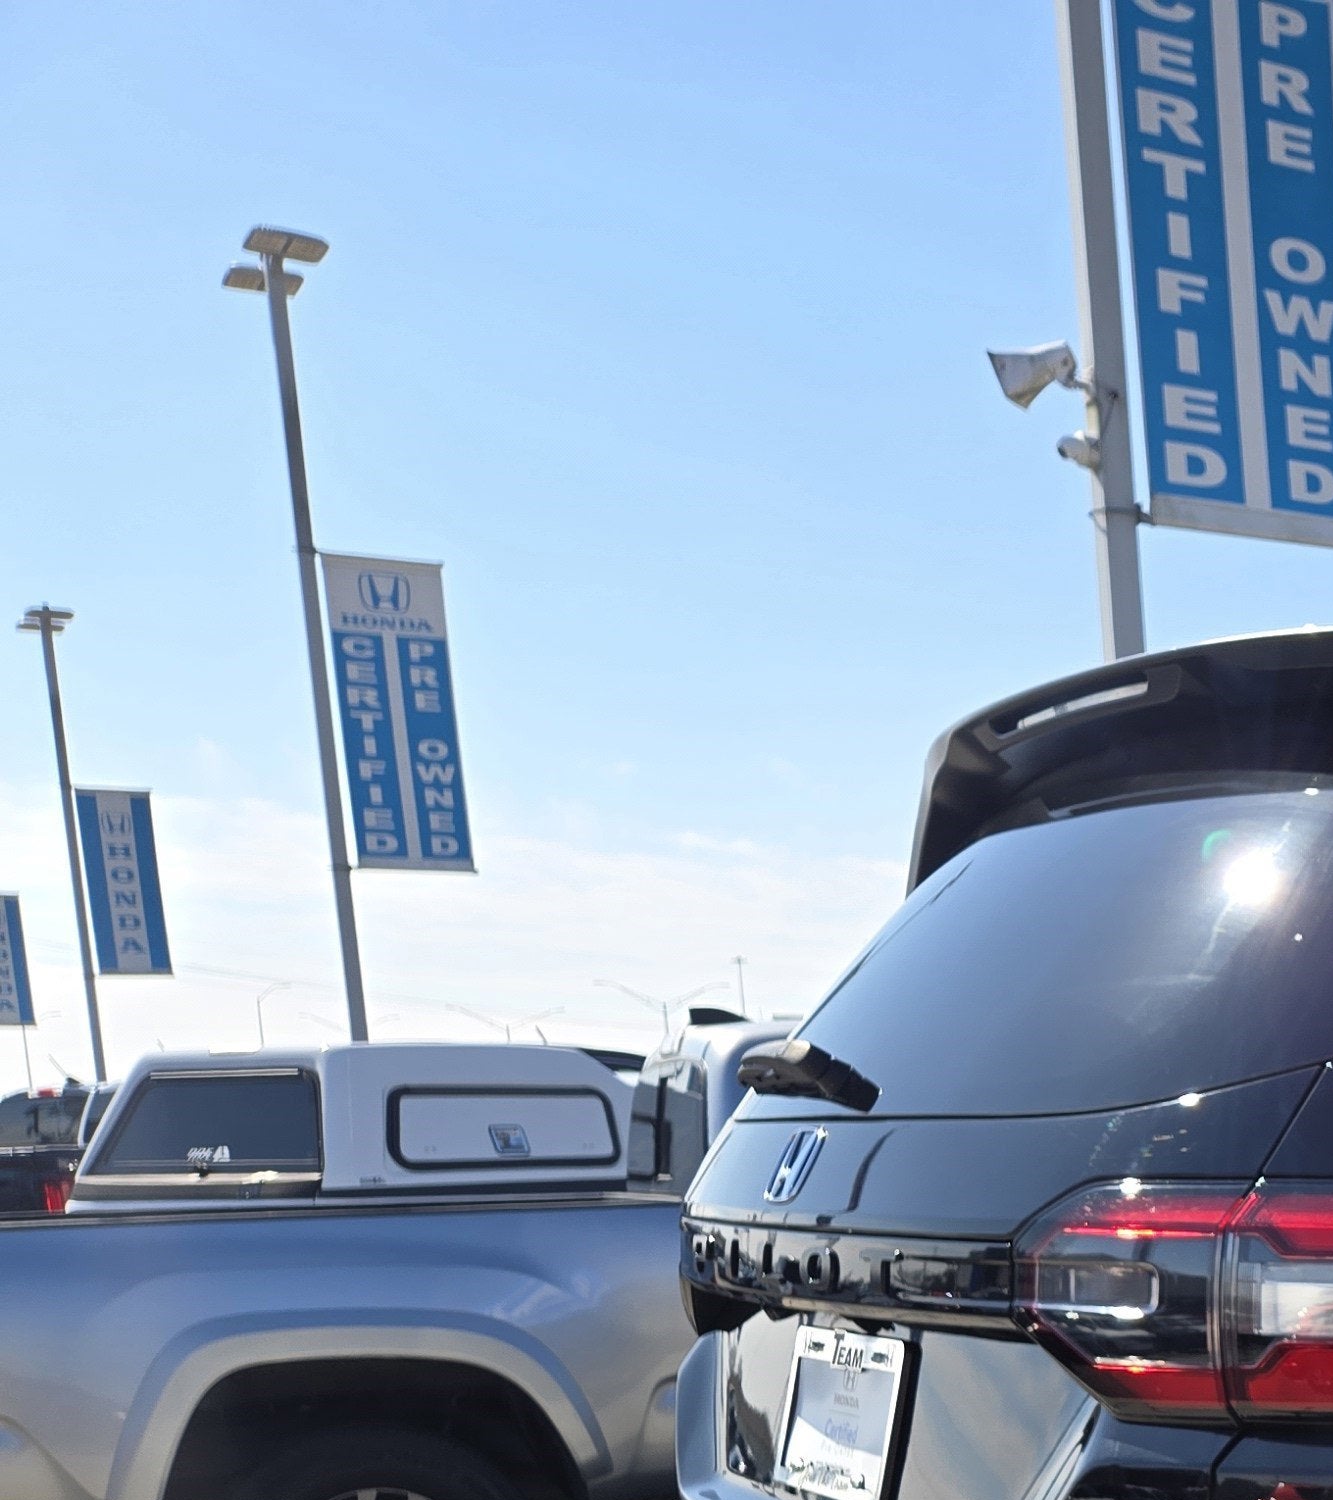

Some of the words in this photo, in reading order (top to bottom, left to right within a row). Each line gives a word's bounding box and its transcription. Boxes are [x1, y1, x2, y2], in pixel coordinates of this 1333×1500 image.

[1258, 1, 1316, 173] PRE
[340, 612, 434, 633] HONDA
[408, 641, 442, 714] PRE
[341, 636, 399, 854] CERTIFIED
[416, 738, 460, 857] OWNED
[106, 842, 147, 955] HONDA
[831, 1333, 864, 1369] TEAM
